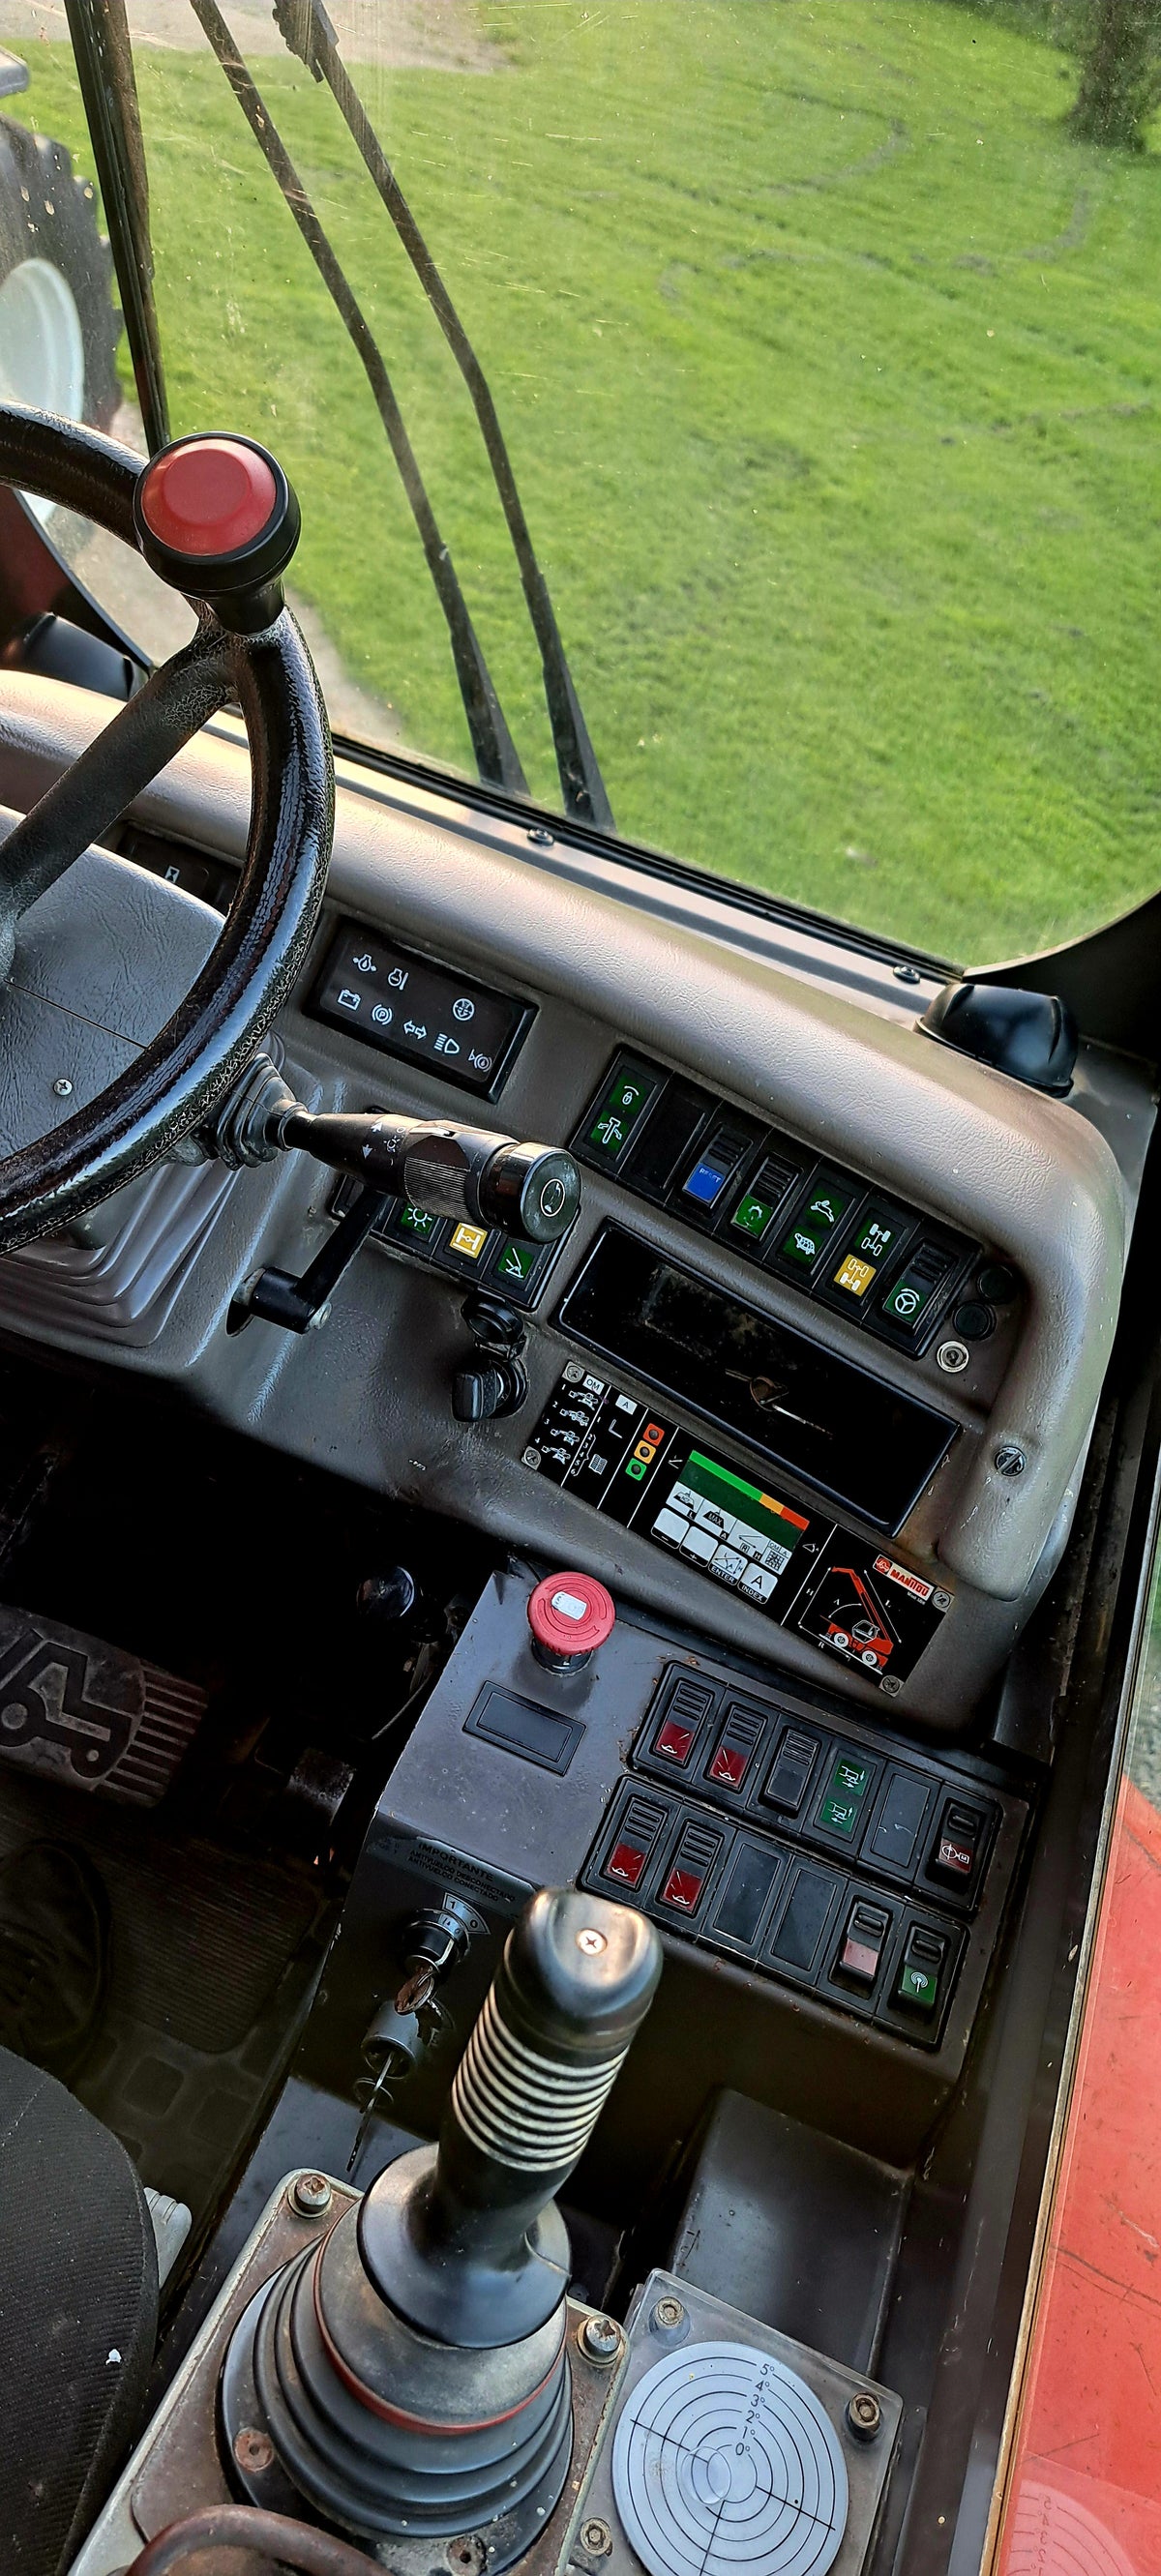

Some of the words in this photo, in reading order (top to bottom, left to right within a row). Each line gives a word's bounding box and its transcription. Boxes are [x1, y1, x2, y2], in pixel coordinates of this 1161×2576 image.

[622, 1401, 629, 1409] A
[708, 1513, 723, 1525] MAX
[711, 1565, 735, 1584] ENTER
[750, 1575, 763, 1589] A
[889, 1568, 930, 1596] MANITOU
[741, 1584, 763, 1601] INDEX
[418, 1842, 494, 1881] IMPORTANTE
[408, 1855, 454, 1880] ANTIVUELCO
[454, 1878, 498, 1902] CONECTADO
[450, 1901, 456, 1910] 1
[759, 2363, 775, 2376] 5°
[755, 2380, 770, 2392] 4°
[750, 2393, 765, 2407] 3°
[745, 2410, 760, 2424] 2°
[742, 2425, 756, 2439] 1°
[735, 2442, 751, 2456] 0°
